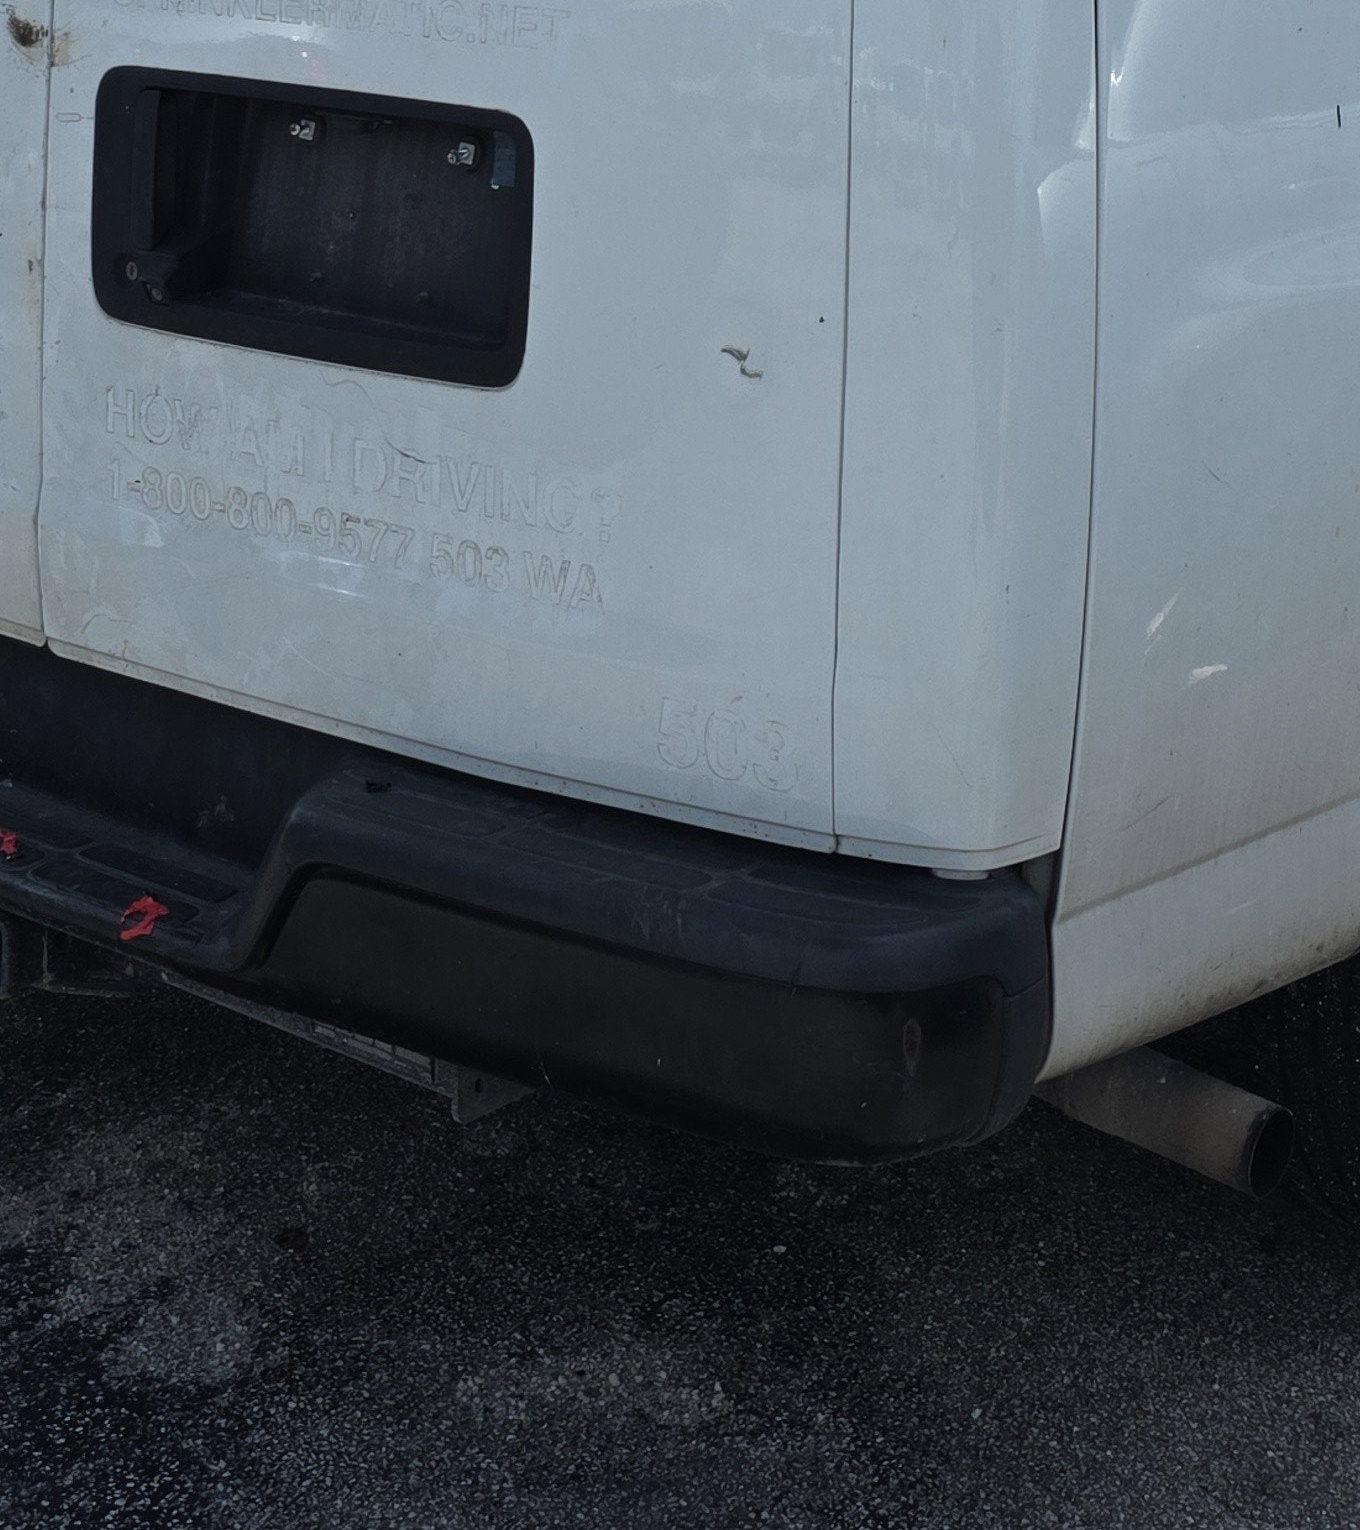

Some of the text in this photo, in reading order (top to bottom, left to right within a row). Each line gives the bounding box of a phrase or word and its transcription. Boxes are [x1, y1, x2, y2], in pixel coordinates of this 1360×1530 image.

[106, 457, 607, 615] 1-800-800-9577 503 WA
[351, 437, 624, 544] DRIVING?
[656, 696, 800, 794] 503
